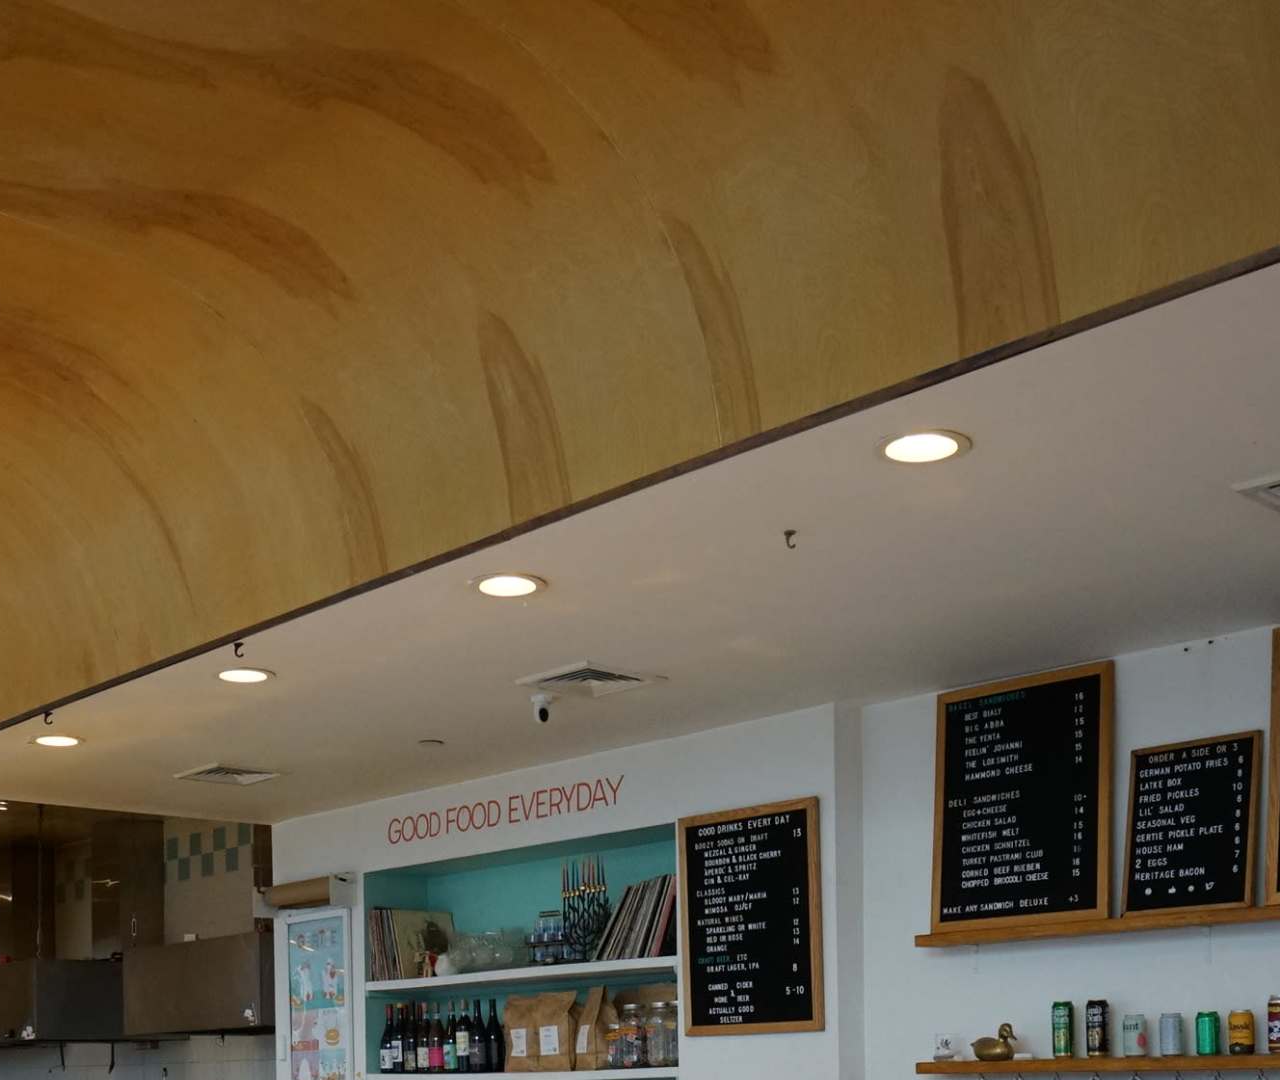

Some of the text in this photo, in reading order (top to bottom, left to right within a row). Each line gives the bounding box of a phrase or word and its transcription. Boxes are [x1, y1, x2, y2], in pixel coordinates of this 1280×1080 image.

[1149, 745, 1226, 763] ORDER SIDE OR
[965, 764, 1033, 781] HAMMOND CHEESE
[1140, 758, 1228, 778] GERMAN POTATO FRIES
[1140, 778, 1182, 790] LATKE BOX
[973, 790, 1020, 804] SANDWICHES
[1139, 794, 1161, 803] FRIED
[1167, 788, 1200, 800] PICKLES
[388, 774, 625, 845] GOOD FOOD EVERYDAY
[1159, 804, 1184, 813] SALAD
[698, 815, 790, 836] GOOD DRINKS EVERY DAY
[962, 816, 1016, 830] CHICKEN SALAD
[1136, 816, 1196, 829] SEASONAL VEG
[961, 830, 997, 842] WHITEFISH
[1136, 825, 1224, 842] GERTIE PICKLE PLATE
[962, 839, 1031, 854] CHICKEN SCHNITZEL
[1136, 843, 1184, 855] HOUSE HAM
[962, 849, 1043, 867] TURKEY PASTRAMI CLUB
[1147, 858, 1168, 867] EGGS
[962, 868, 988, 878] CORNED
[1135, 866, 1205, 880] HERITAGE BACON
[962, 877, 989, 889] CHOPPED
[697, 888, 725, 898] CLASSICS
[705, 905, 728, 914] MIMOSA
[943, 897, 1048, 914] MAKE ANY SANDWICH DELUXE
[708, 983, 728, 991] CANNED
[709, 1005, 754, 1015] ACTUALLY GOOD
